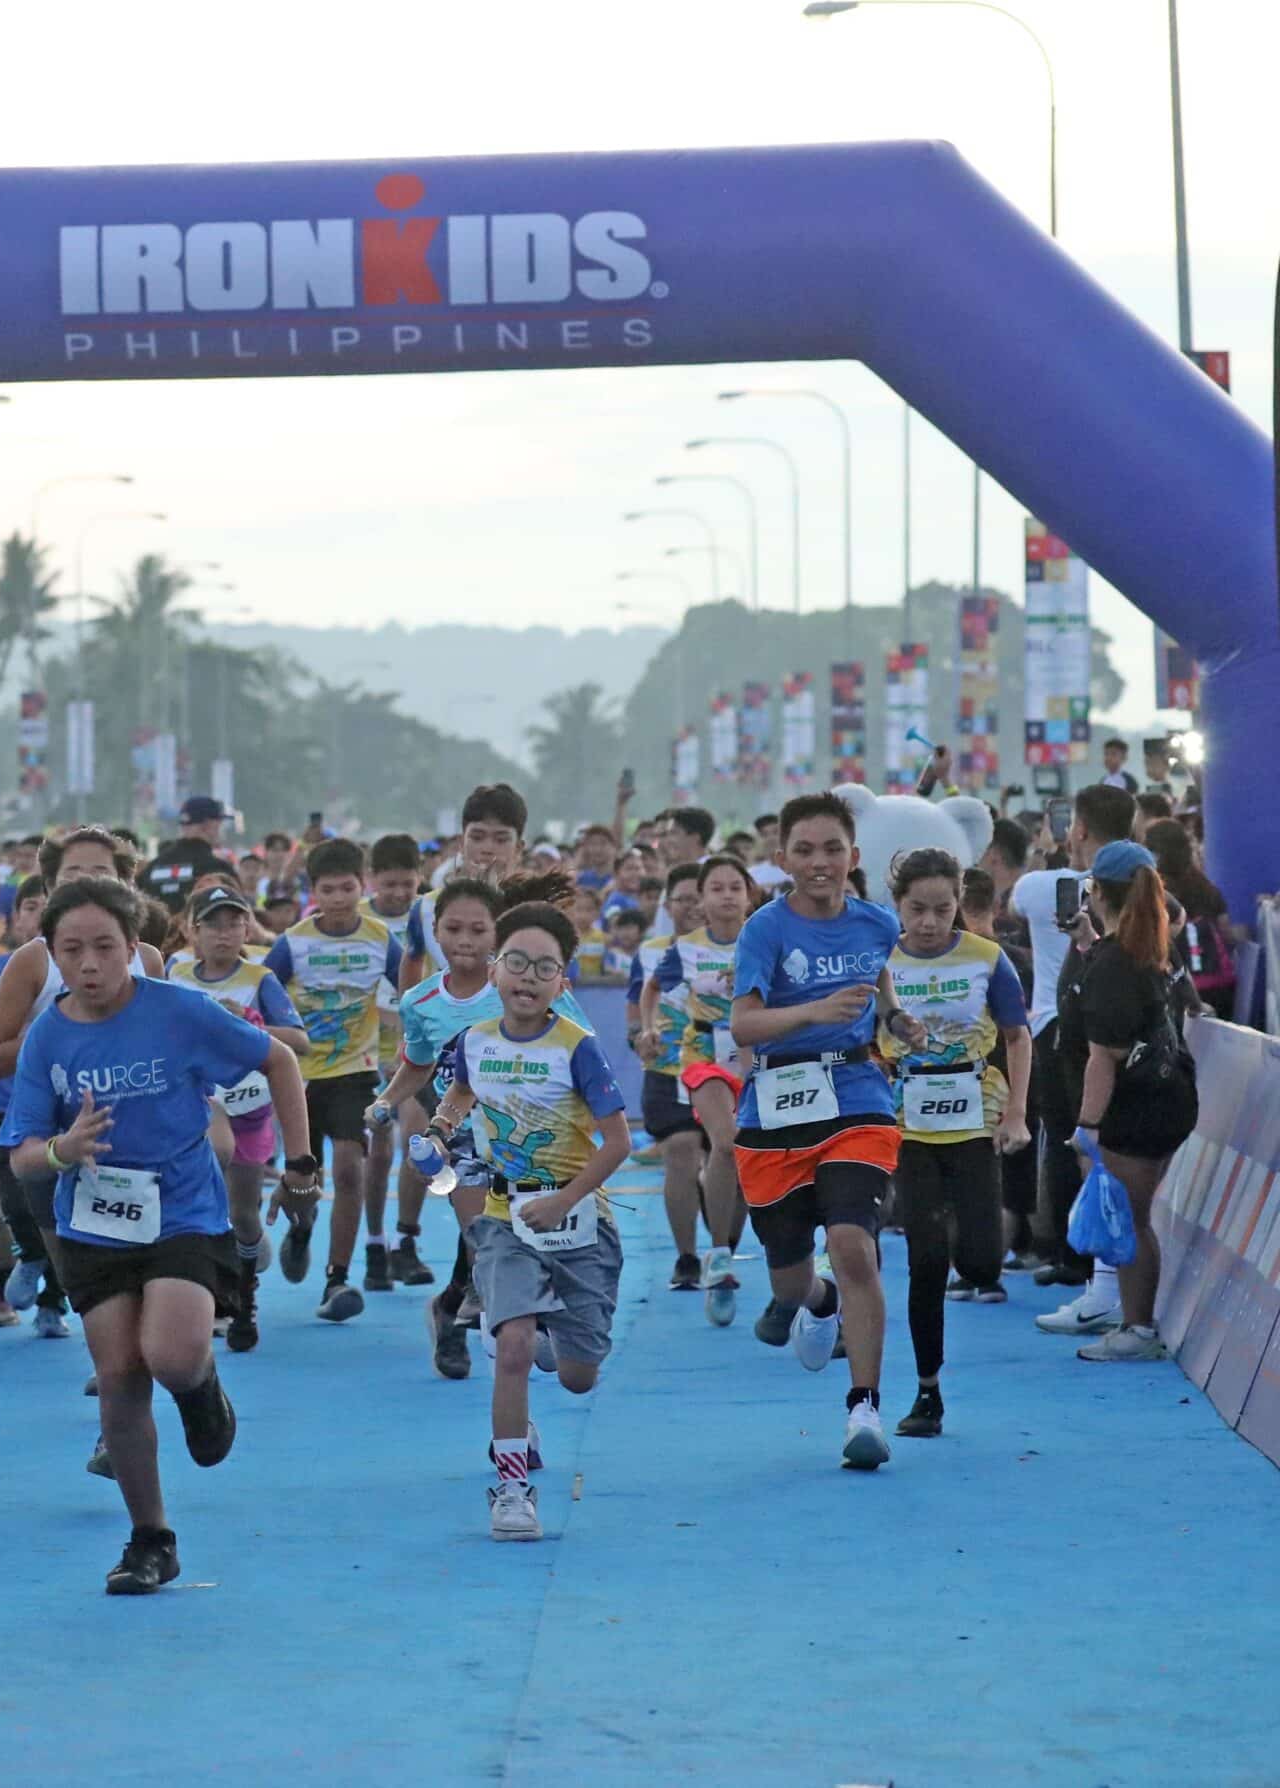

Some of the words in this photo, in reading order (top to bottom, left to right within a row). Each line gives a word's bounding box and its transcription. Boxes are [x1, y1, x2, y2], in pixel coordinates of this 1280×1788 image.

[60, 174, 651, 314] IRONKIDS
[64, 318, 653, 360] PHILIPPINES
[76, 1058, 167, 1094] SURGE
[224, 1086, 260, 1104] 276
[776, 1089, 819, 1110] 287
[920, 1099, 968, 1115] 260
[91, 1198, 143, 1221] 246
